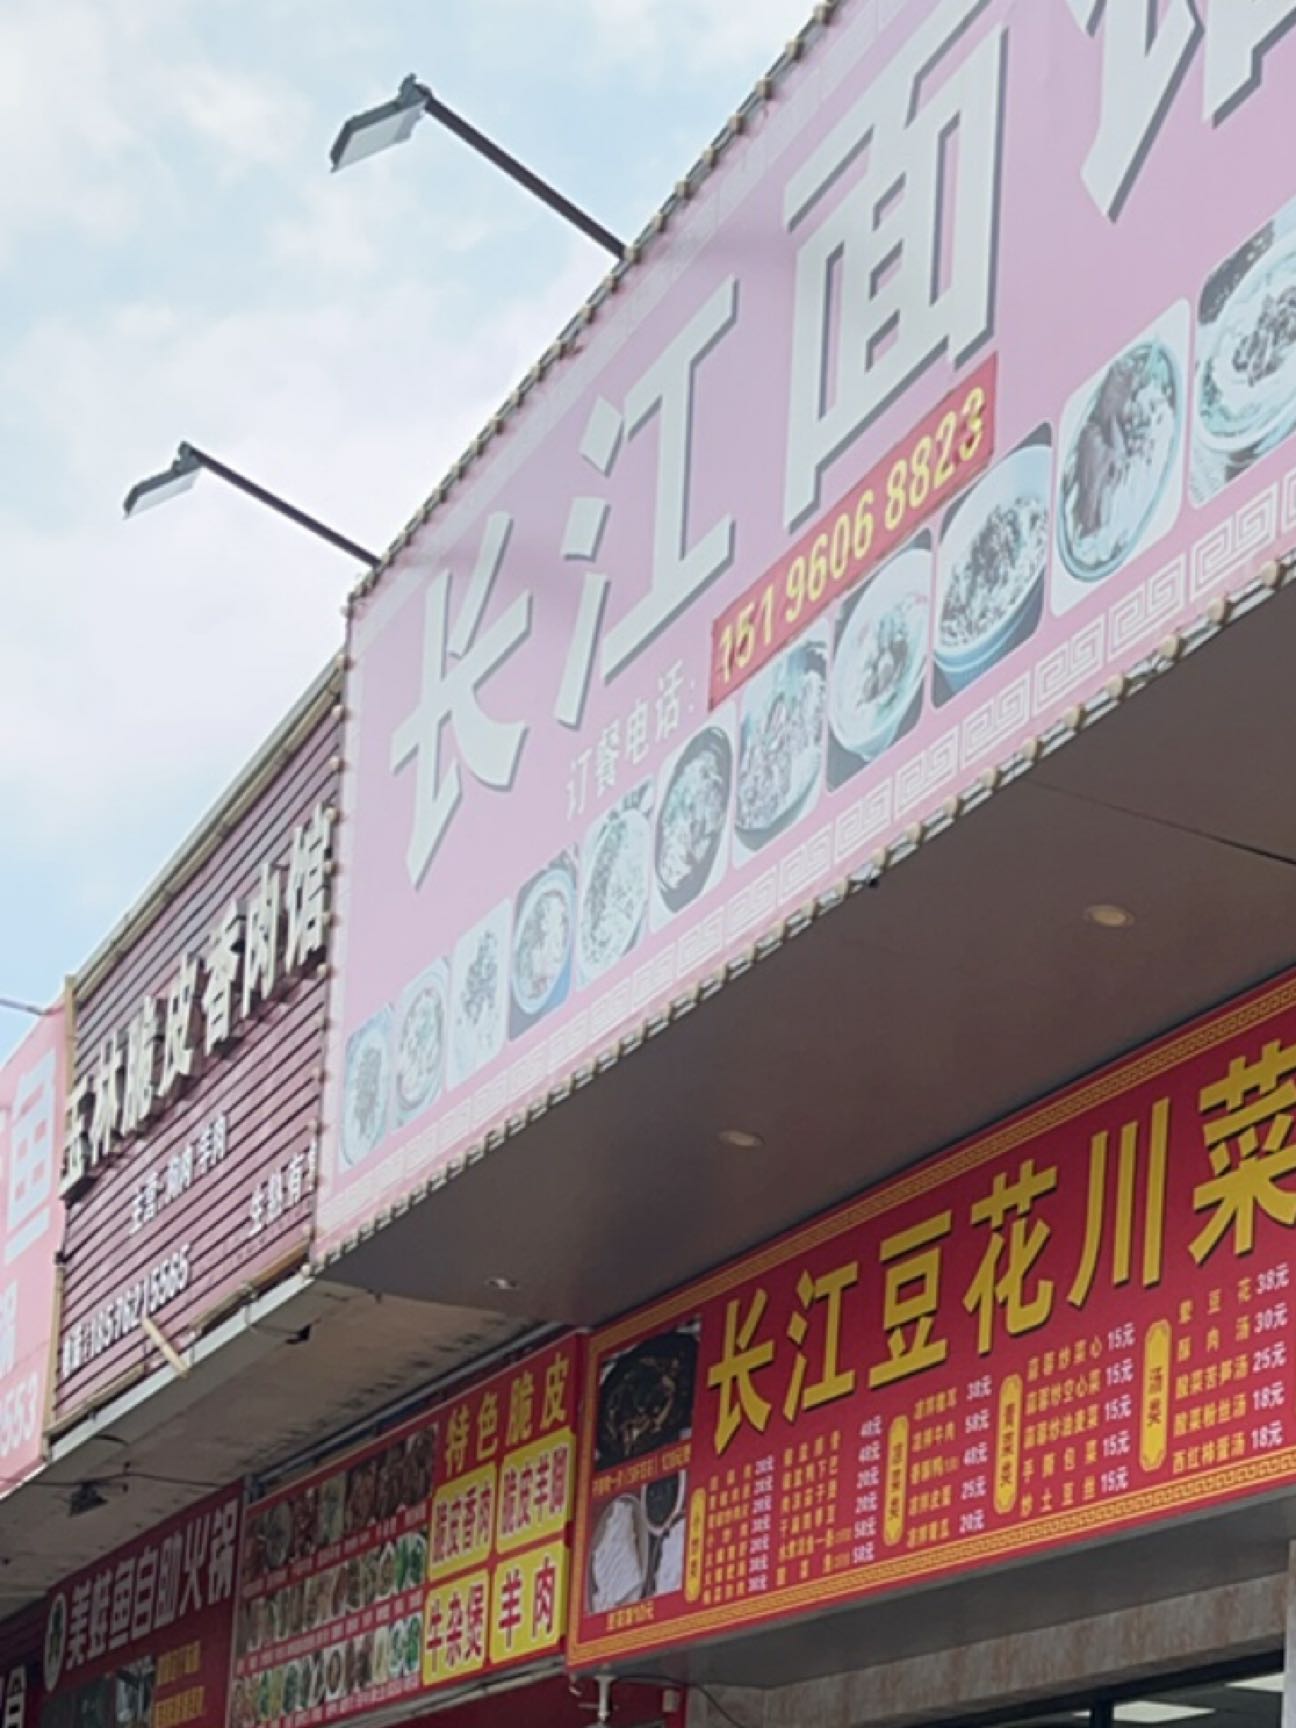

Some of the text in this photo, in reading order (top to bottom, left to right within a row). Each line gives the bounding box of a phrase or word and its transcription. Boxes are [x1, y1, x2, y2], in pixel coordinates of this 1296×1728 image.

[715, 587, 776, 684] 151
[785, 488, 875, 622] 9606
[884, 387, 987, 532] 8823
[58, 803, 331, 1198] 玉林脆皮香肉馆
[446, 1352, 570, 1477] 特色脆皮
[498, 1555, 557, 1651] 羊肉
